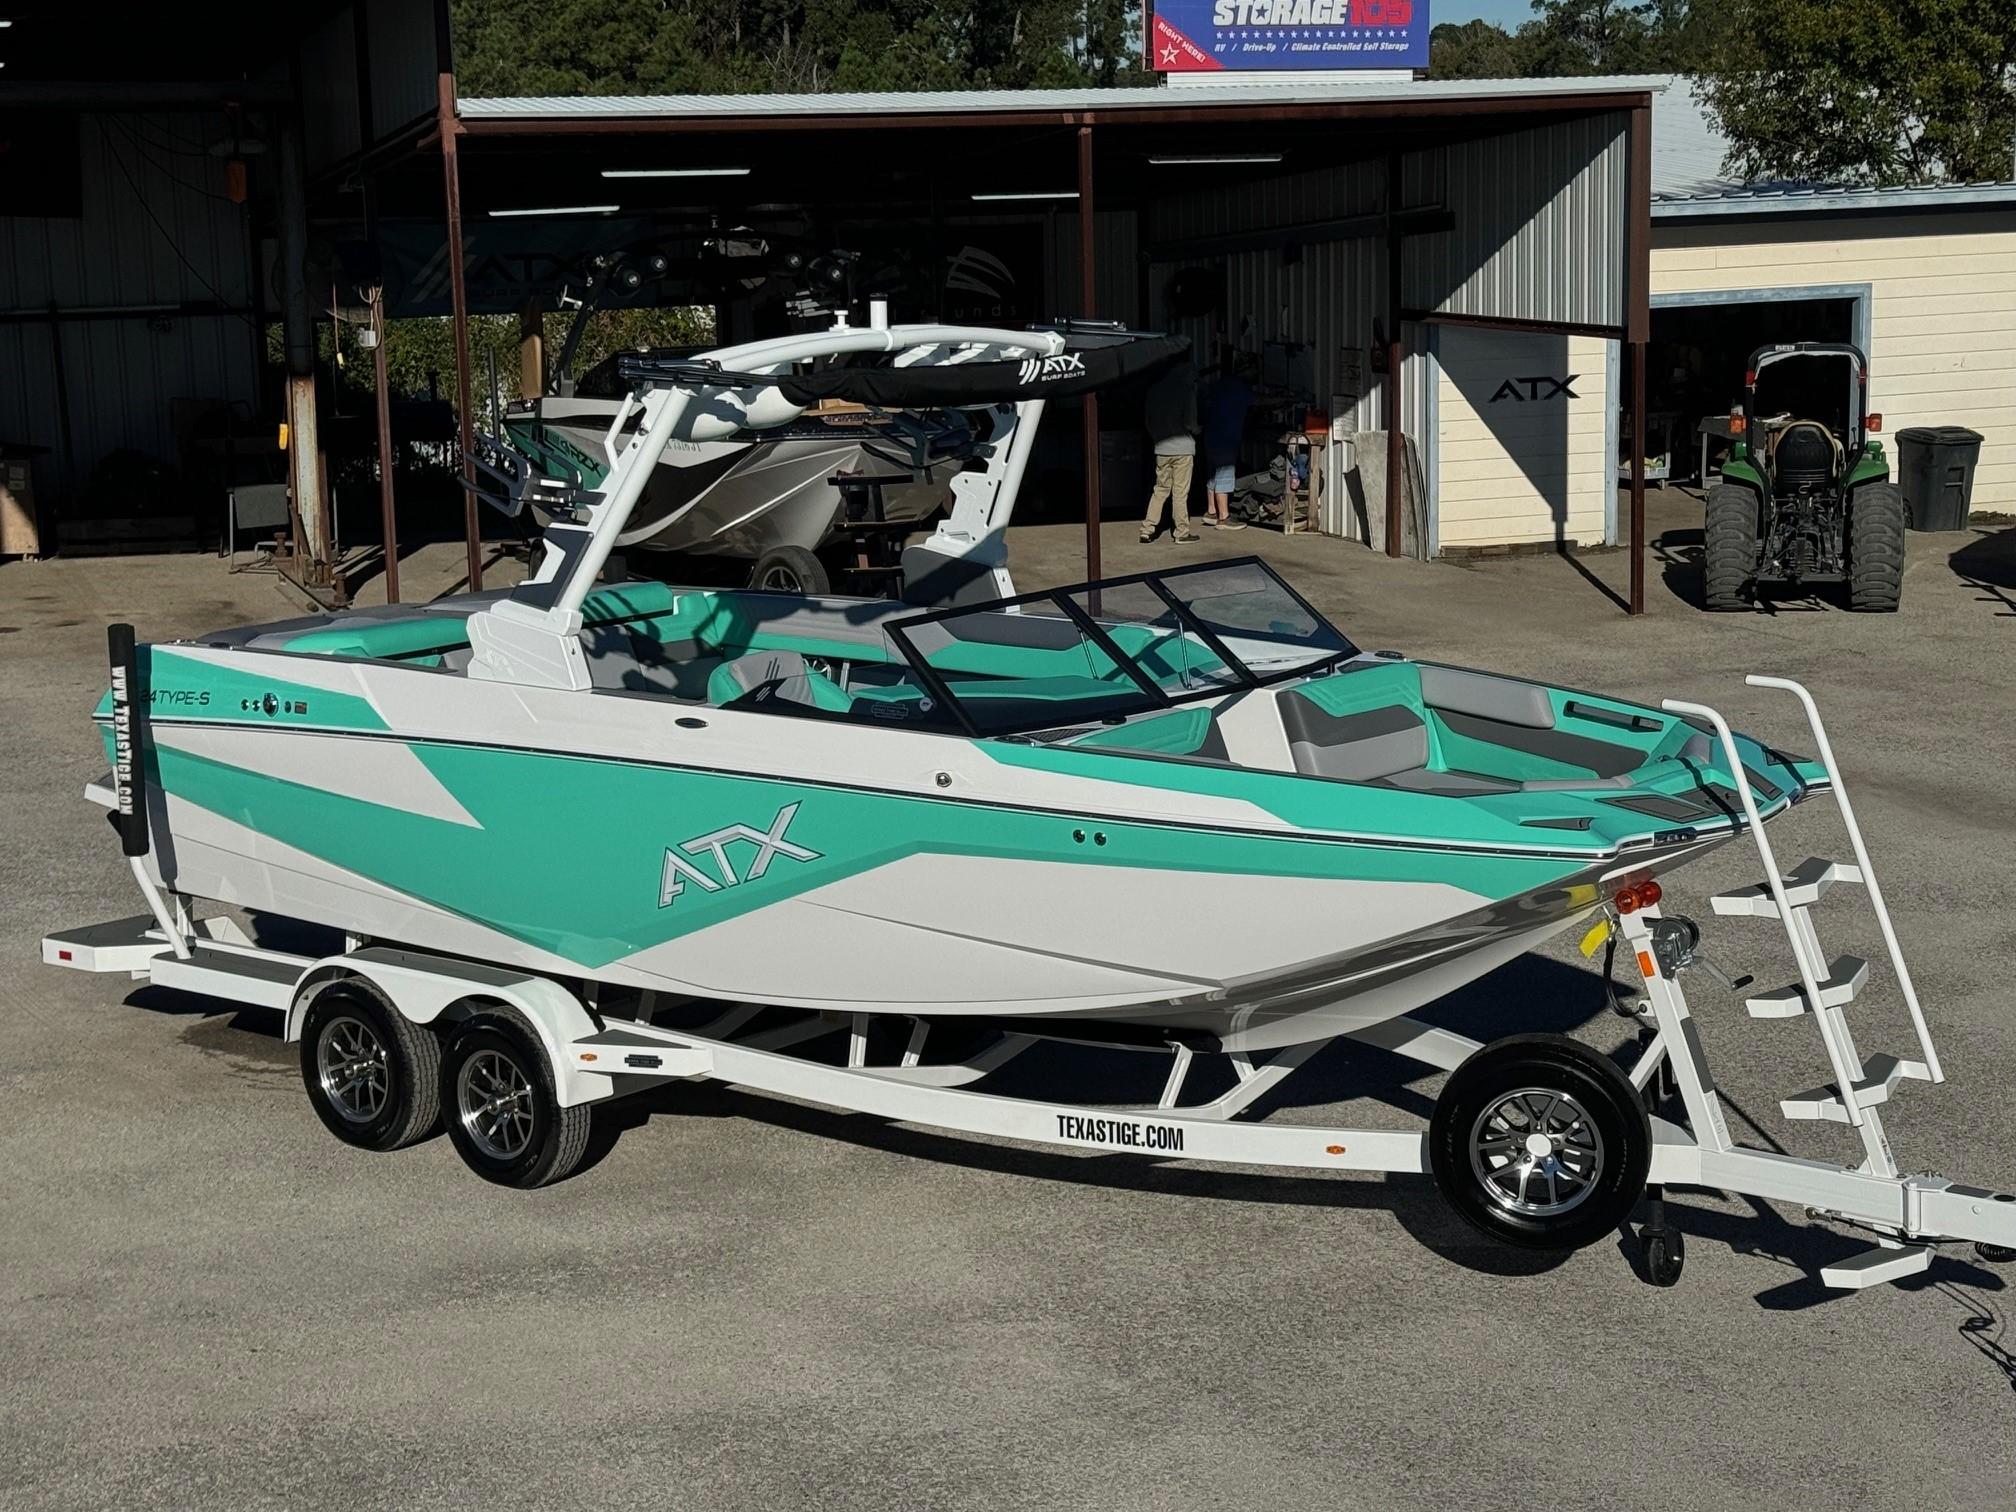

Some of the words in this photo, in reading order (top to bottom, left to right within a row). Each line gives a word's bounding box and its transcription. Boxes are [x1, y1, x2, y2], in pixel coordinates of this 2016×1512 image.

[1213, 0, 1348, 26] STORAGE
[1158, 21, 1183, 44] RIGHT
[1242, 42, 1277, 53] Drive-Up
[1291, 42, 1321, 52] Climate
[1322, 42, 1362, 51] Controlled
[1363, 42, 1379, 51] Self
[1380, 42, 1410, 53] Storage
[1042, 352, 1086, 374] ATX
[1041, 374, 1062, 382] SURF
[1063, 370, 1086, 379] BOATS
[1488, 374, 1581, 402] ATX
[658, 799, 826, 910] ATX
[1056, 1114, 1184, 1151] TEXASTIGE.COM
